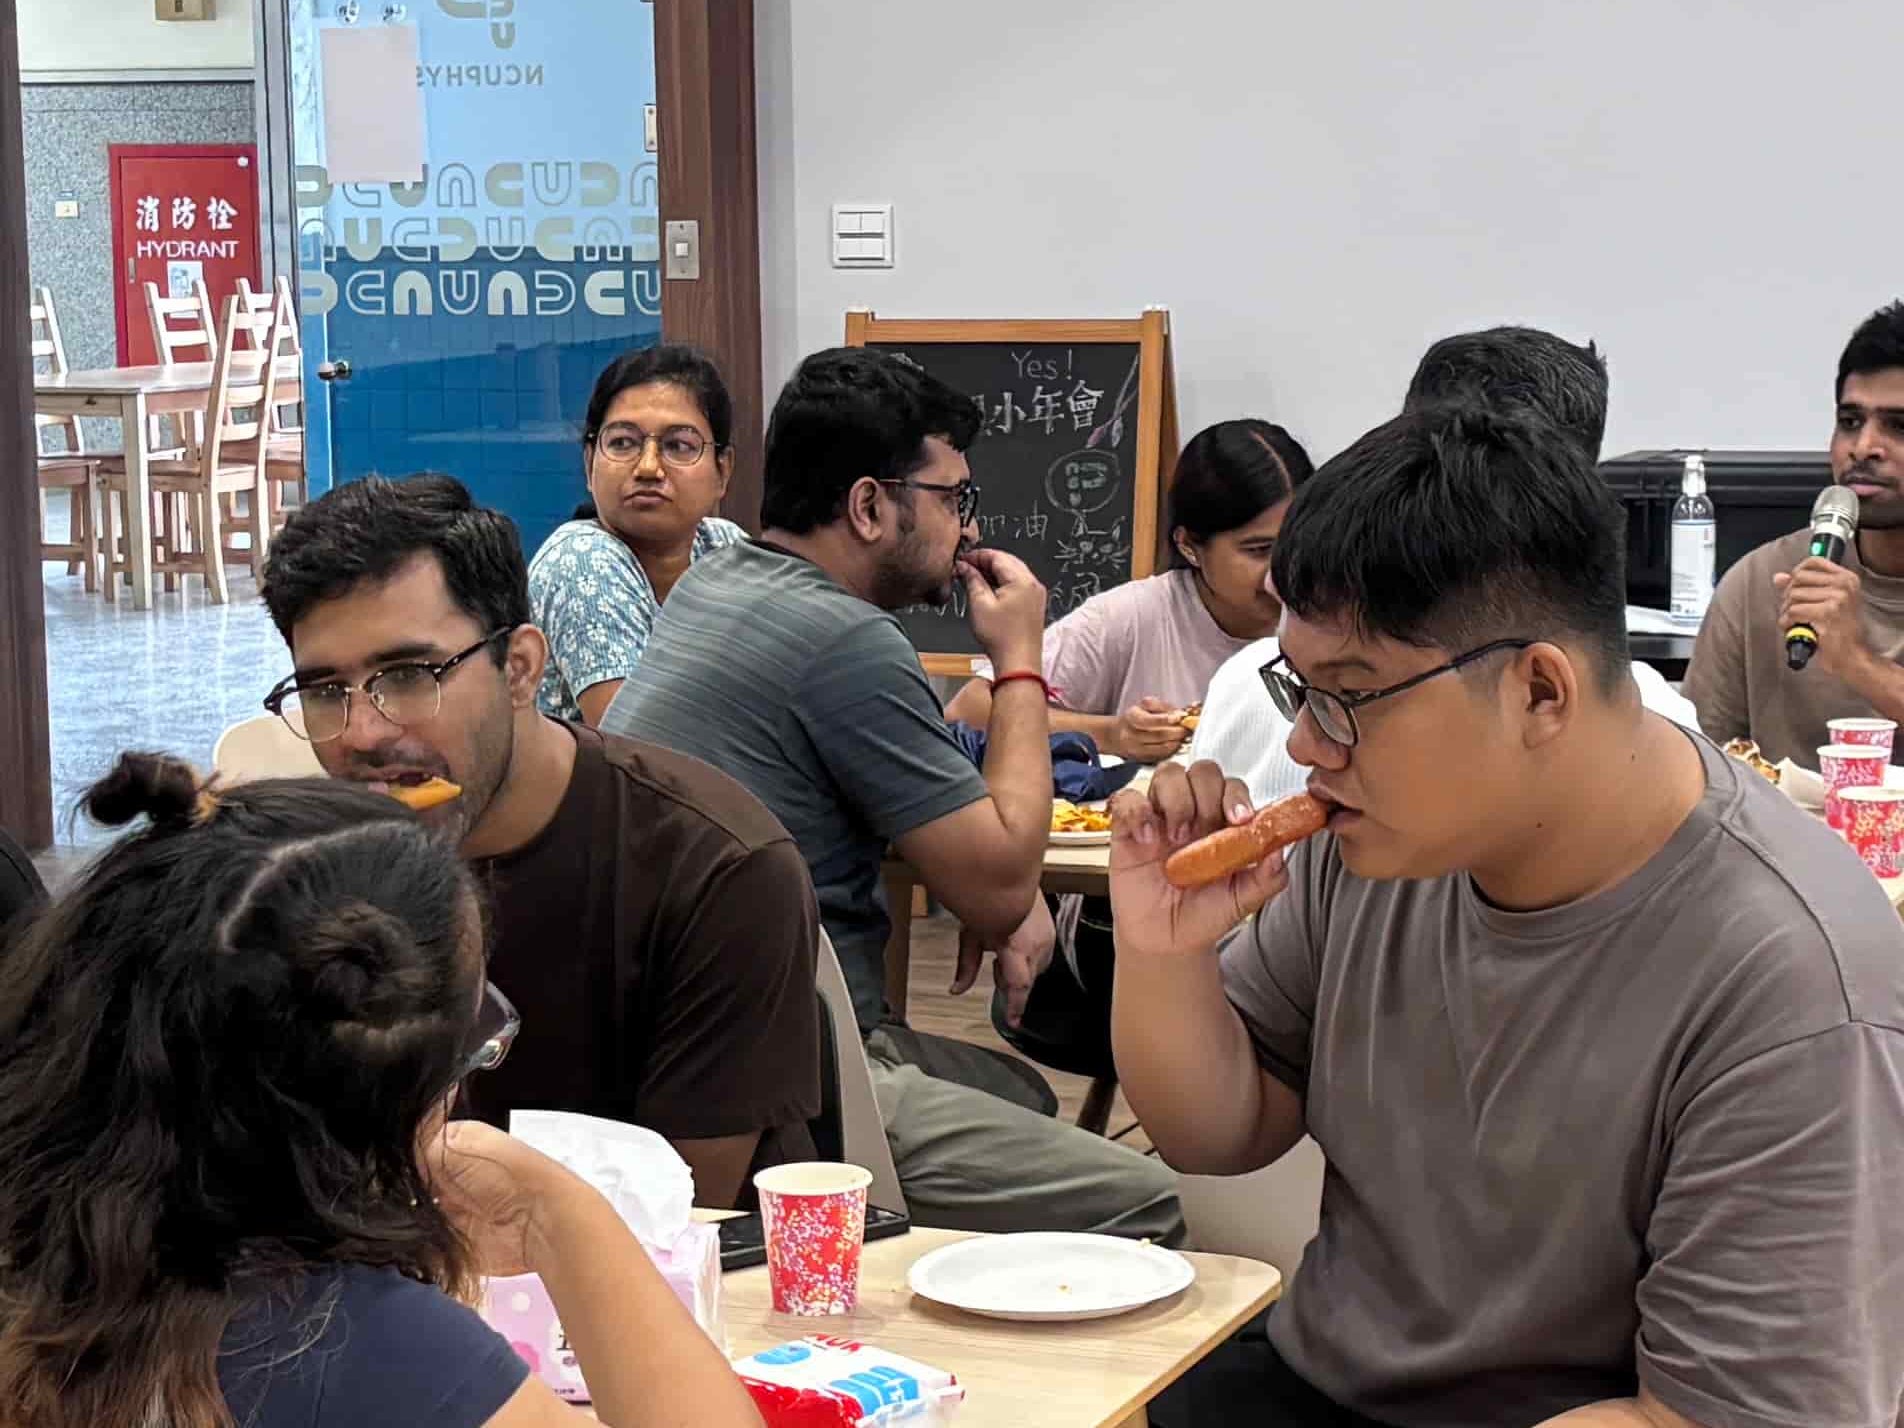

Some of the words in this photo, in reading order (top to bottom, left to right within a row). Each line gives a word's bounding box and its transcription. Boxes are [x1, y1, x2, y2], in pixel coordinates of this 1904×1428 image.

[136, 195, 239, 232] 消防栓
[136, 239, 240, 259] HYDRANT
[1011, 348, 1073, 381] Yes!
[970, 380, 1105, 437] 小年會
